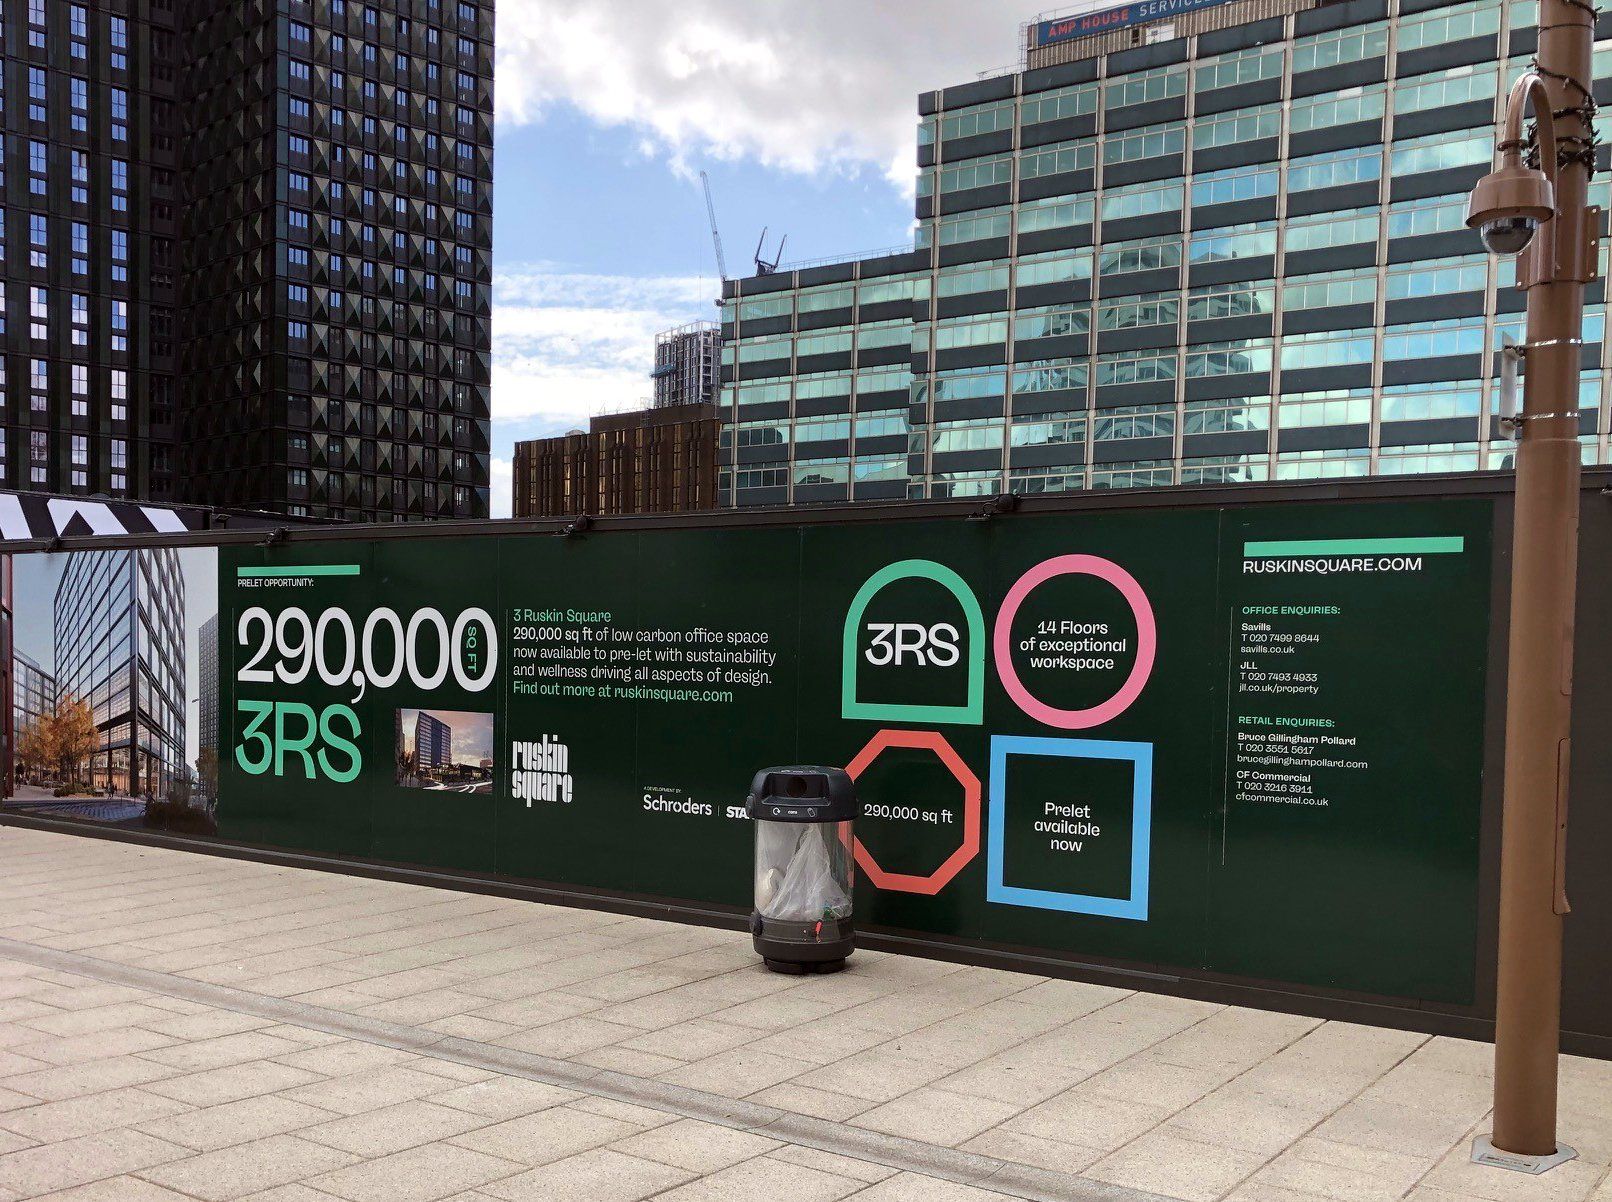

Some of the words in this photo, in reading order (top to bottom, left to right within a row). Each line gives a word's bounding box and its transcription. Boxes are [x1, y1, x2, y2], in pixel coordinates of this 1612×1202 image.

[1048, 21, 1076, 37] AMP
[1082, 9, 1130, 30] HOUSE
[1139, 0, 1211, 16] SERVIC
[1243, 558, 1421, 574] RUSKINSQUARE.COM
[238, 579, 263, 587] PRELET
[264, 578, 313, 587] OPPORTUNITY:
[514, 609, 521, 621] 3
[525, 609, 563, 621] Ruskin
[567, 609, 611, 624] Square
[1242, 606, 1278, 614] OFFICE
[1281, 606, 1340, 615] ENQUIRIES:
[1038, 621, 1056, 634] 14
[1061, 621, 1108, 634] Floors
[1242, 623, 1271, 631] Savills
[467, 626, 476, 648] SQ
[514, 627, 562, 642] 290,000
[565, 630, 579, 643] sq
[582, 627, 592, 641] ft
[596, 627, 609, 641] of
[612, 628, 633, 641] low
[636, 629, 681, 642] carbon
[685, 628, 723, 642] office
[727, 632, 768, 645] space
[1250, 634, 1267, 642] 020
[1270, 634, 1292, 642] 7499
[1295, 634, 1319, 642] 8644
[864, 622, 961, 667] 3RS
[1020, 637, 1036, 651] of
[1039, 638, 1126, 654] exceptional
[1241, 645, 1294, 653] savills.co.uk
[236, 606, 498, 704] 290,000
[468, 654, 476, 672] FT
[514, 648, 537, 658] now
[541, 646, 590, 659] available
[593, 647, 606, 659] to
[610, 647, 651, 662] pre-let
[655, 648, 682, 661] with
[687, 649, 776, 666] sustainability
[1030, 655, 1114, 671] workspace
[514, 664, 534, 676] and
[538, 664, 587, 678] wellness
[591, 665, 631, 682] driving
[635, 667, 648, 679] all
[652, 668, 703, 683] aspects
[707, 668, 721, 682] of
[725, 669, 771, 686] design.
[1240, 672, 1246, 680] T
[1268, 673, 1291, 681] 7493
[1293, 673, 1317, 682] 4933
[514, 681, 537, 694] Find
[540, 683, 560, 695] out
[563, 686, 595, 696] more
[599, 685, 611, 697] at
[615, 685, 732, 702] ruskinsquare.com
[1239, 683, 1319, 694] jll.co.uk/property
[1239, 716, 1273, 725] RETAIL
[1276, 718, 1335, 727] ENQUIRIES:
[235, 700, 362, 783] 3RS
[1238, 733, 1265, 741] Bruce
[1268, 734, 1318, 744] Gillingham
[1321, 736, 1355, 745] Pollard
[511, 733, 570, 772] ruskin
[1238, 743, 1244, 751] T
[1246, 744, 1263, 752] 020
[1265, 745, 1289, 753] 3551
[1291, 746, 1314, 754] 5617
[1237, 754, 1367, 768] brucegillinghampollard.com
[1252, 771, 1310, 783] Commercial
[511, 770, 573, 808] square
[1236, 781, 1242, 789] T
[1244, 782, 1262, 790] 020
[1264, 783, 1287, 792] 3216
[1289, 785, 1313, 794] 3911
[644, 794, 712, 815] Schroders
[725, 806, 750, 820] STA
[1236, 792, 1328, 806] cfcommercial.co.uk
[864, 804, 918, 820] 290,000
[922, 812, 937, 824] sq
[941, 809, 953, 823] ft
[1045, 802, 1090, 818] Prelet
[1034, 820, 1100, 836] available
[1051, 840, 1082, 851] now
